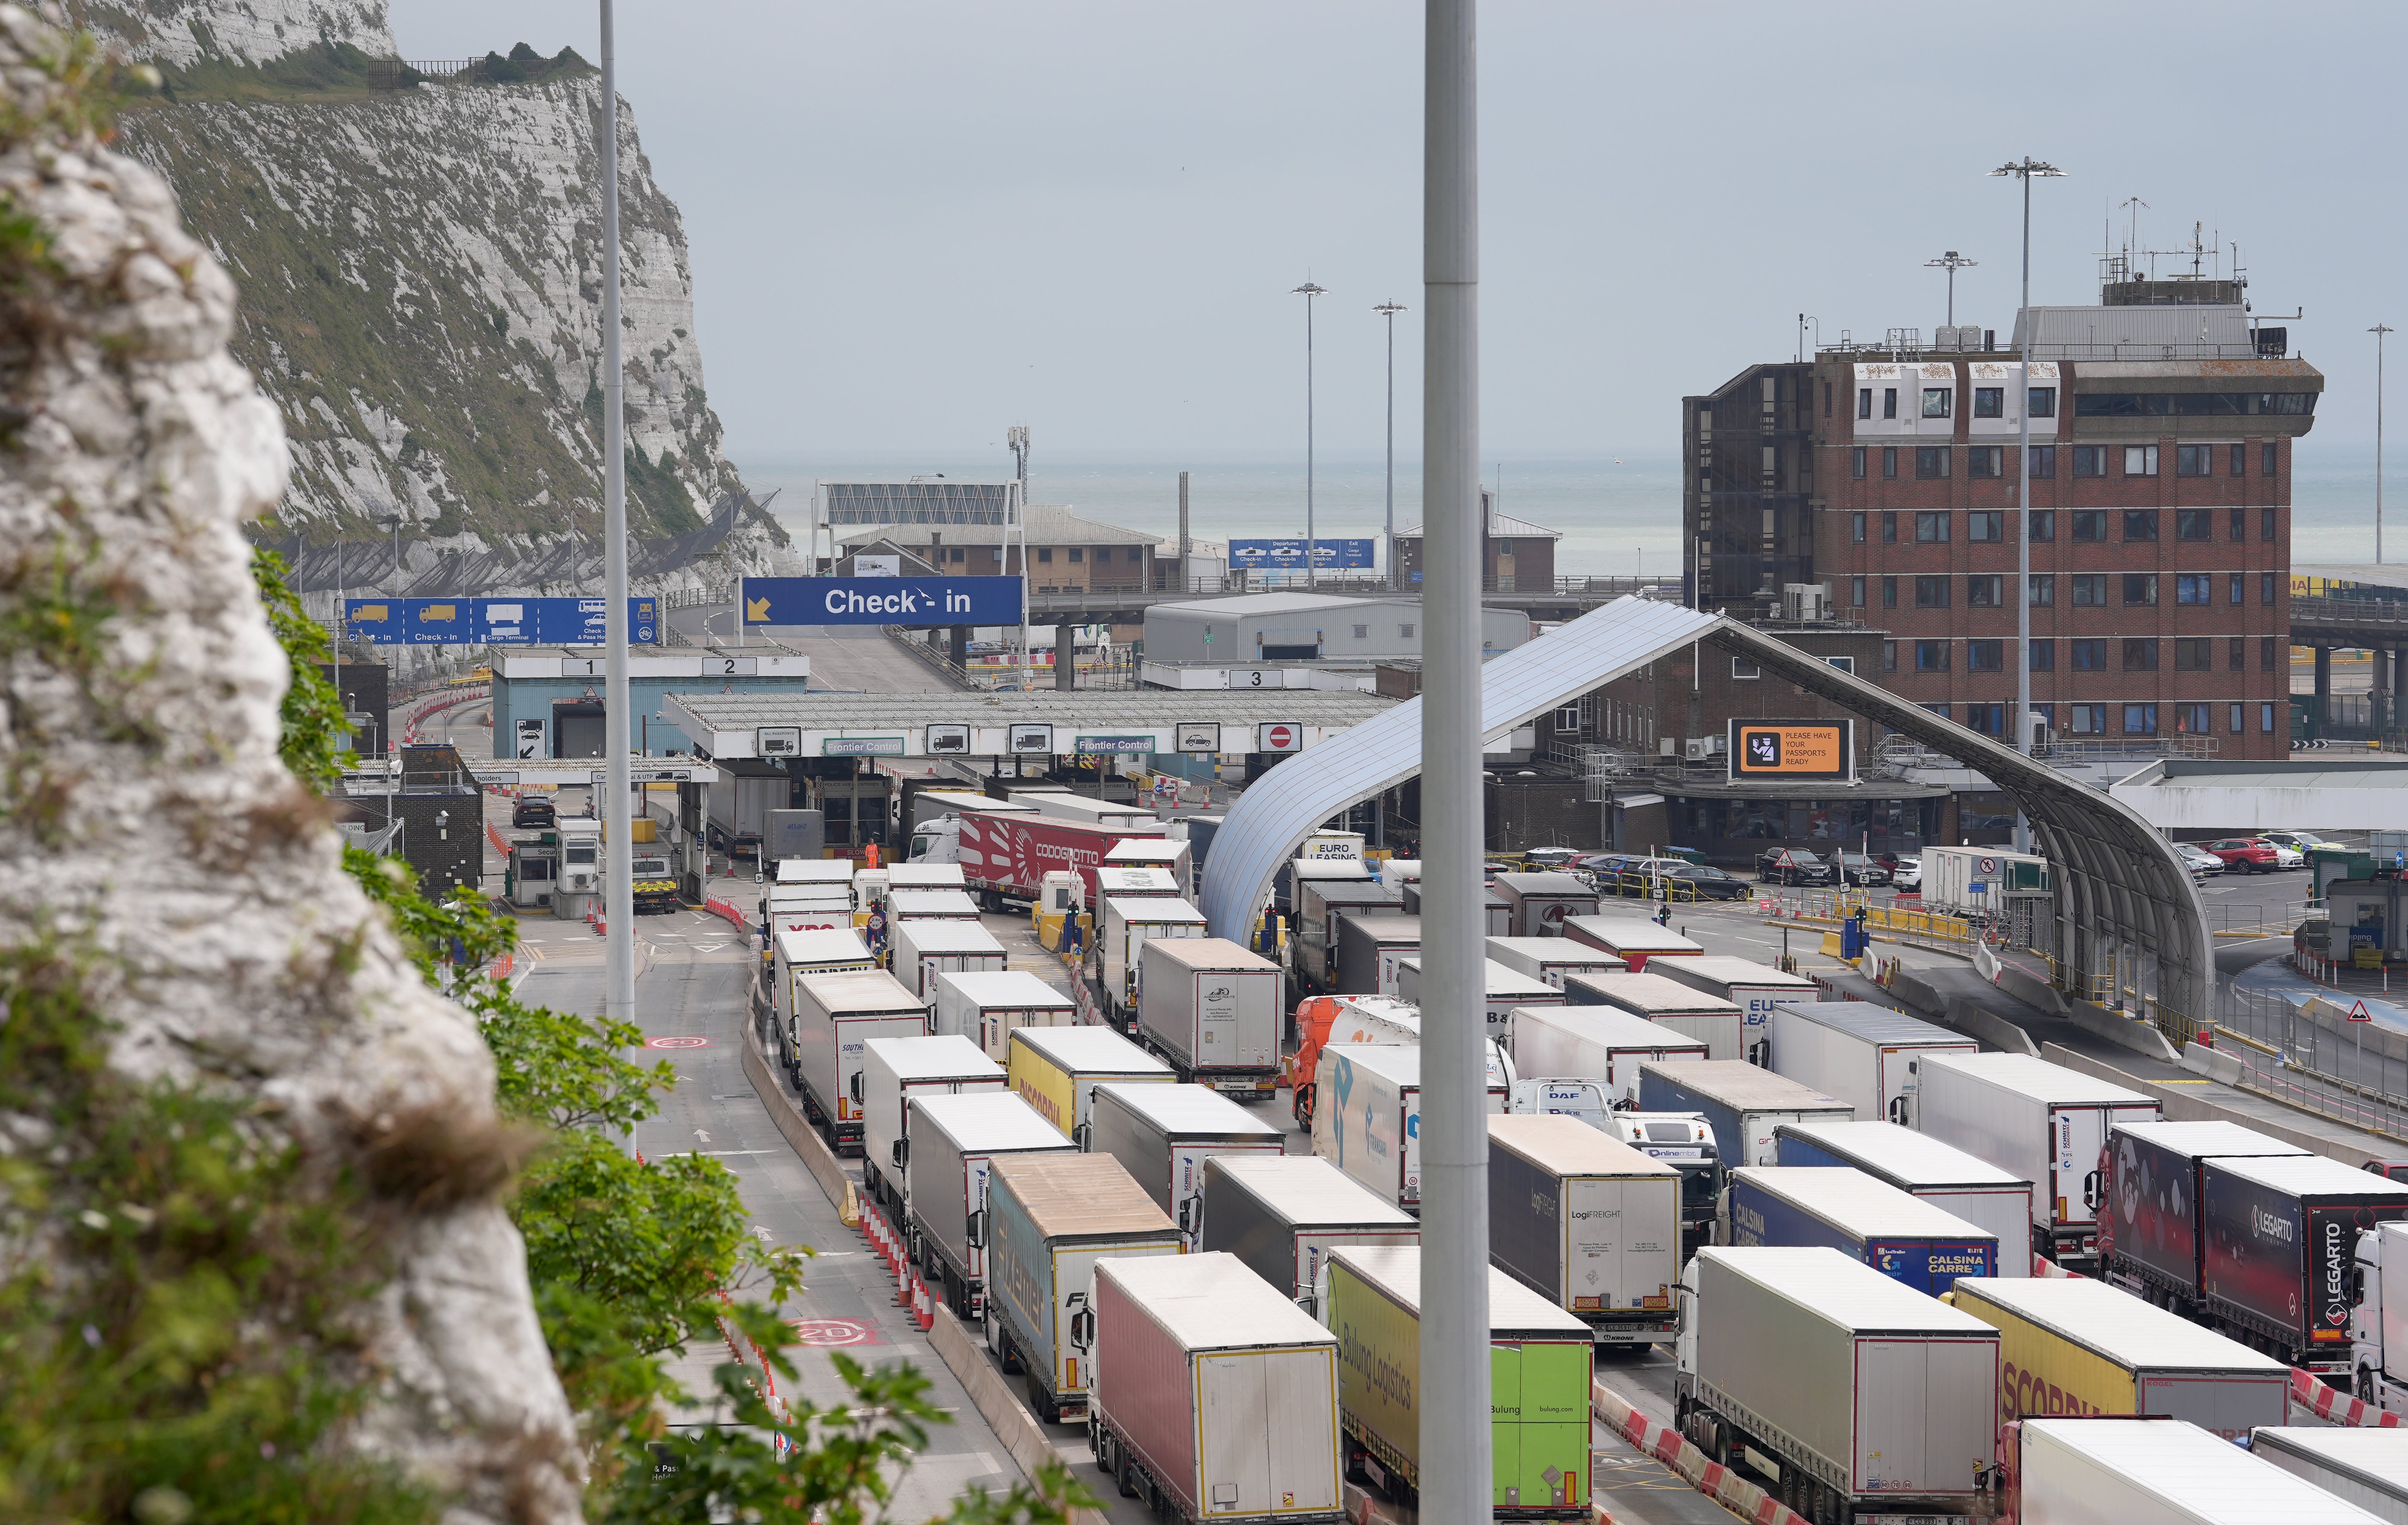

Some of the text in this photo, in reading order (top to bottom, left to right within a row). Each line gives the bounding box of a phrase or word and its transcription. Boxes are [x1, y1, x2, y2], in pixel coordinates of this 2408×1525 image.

[825, 589, 917, 613] Check
[946, 589, 970, 612] in
[586, 660, 593, 674] 1
[725, 659, 735, 674] 2
[1251, 672, 1261, 686] 3
[866, 742, 900, 751] Control
[1118, 740, 1152, 749] Control
[1531, 1188, 1555, 1220] LogiFREIGHT
[1572, 1211, 1620, 1220] LogiFREIGHT
[1736, 1203, 1765, 1236] CALSINA
[2260, 1210, 2293, 1242] LEGARTO
[1928, 1256, 1984, 1264] CALSINA
[2325, 1223, 2340, 1303] LEGARTO
[797, 1328, 852, 1338] 20
[1344, 1322, 1411, 1410] Bulung Logistics
[1490, 1405, 1520, 1415] Bulung
